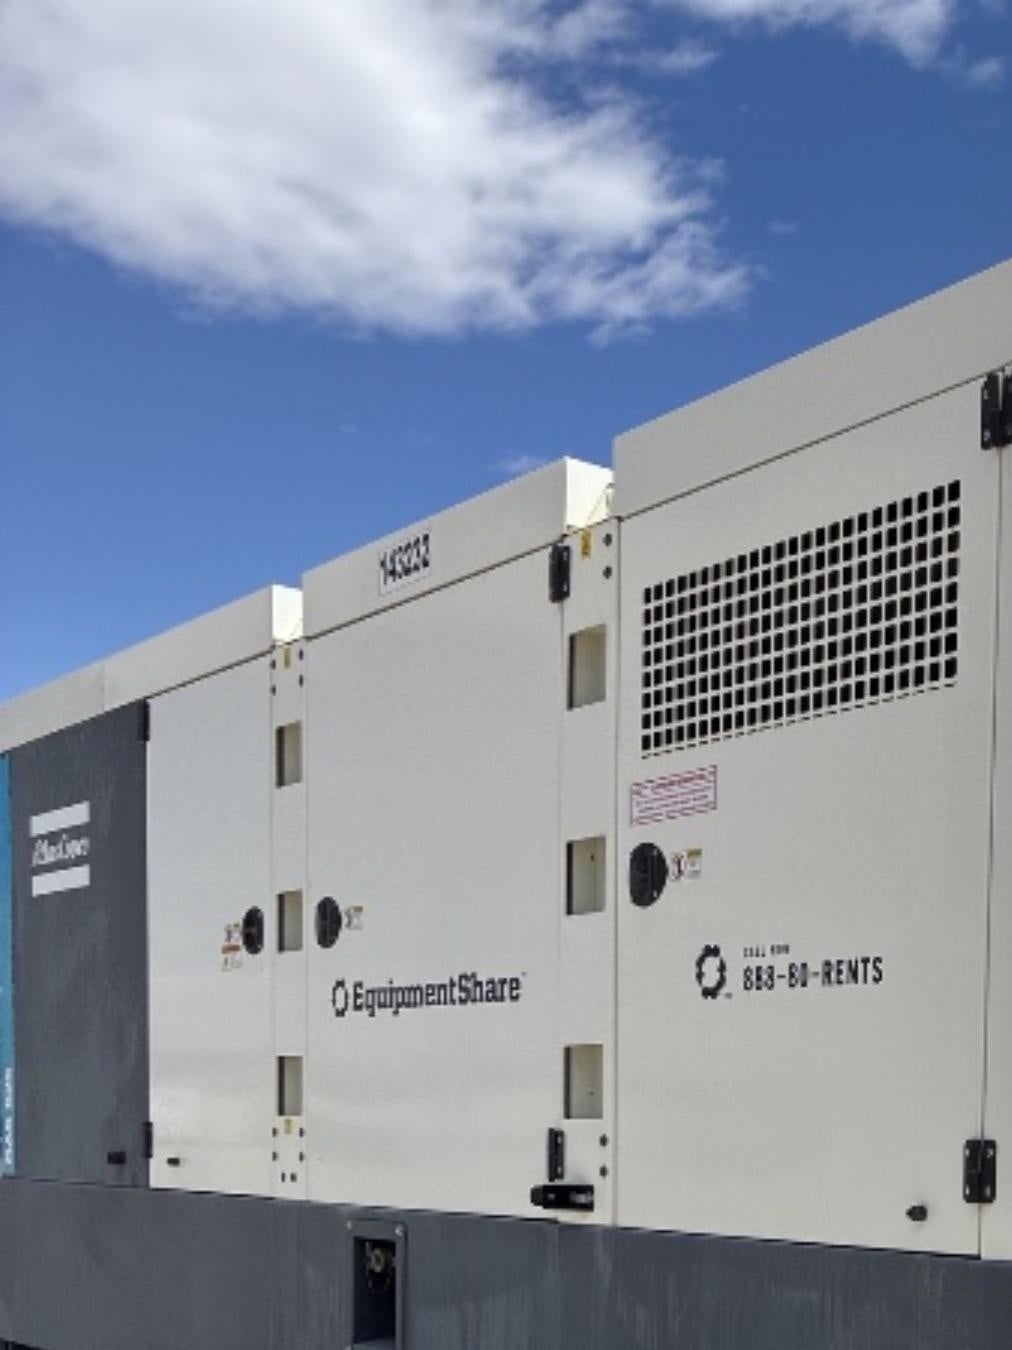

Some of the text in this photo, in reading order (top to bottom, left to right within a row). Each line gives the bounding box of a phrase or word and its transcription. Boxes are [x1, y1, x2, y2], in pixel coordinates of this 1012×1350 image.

[380, 533, 430, 586] 143232
[352, 971, 521, 1018] EquipmentShare
[742, 956, 885, 991] 888-80-RENTS
